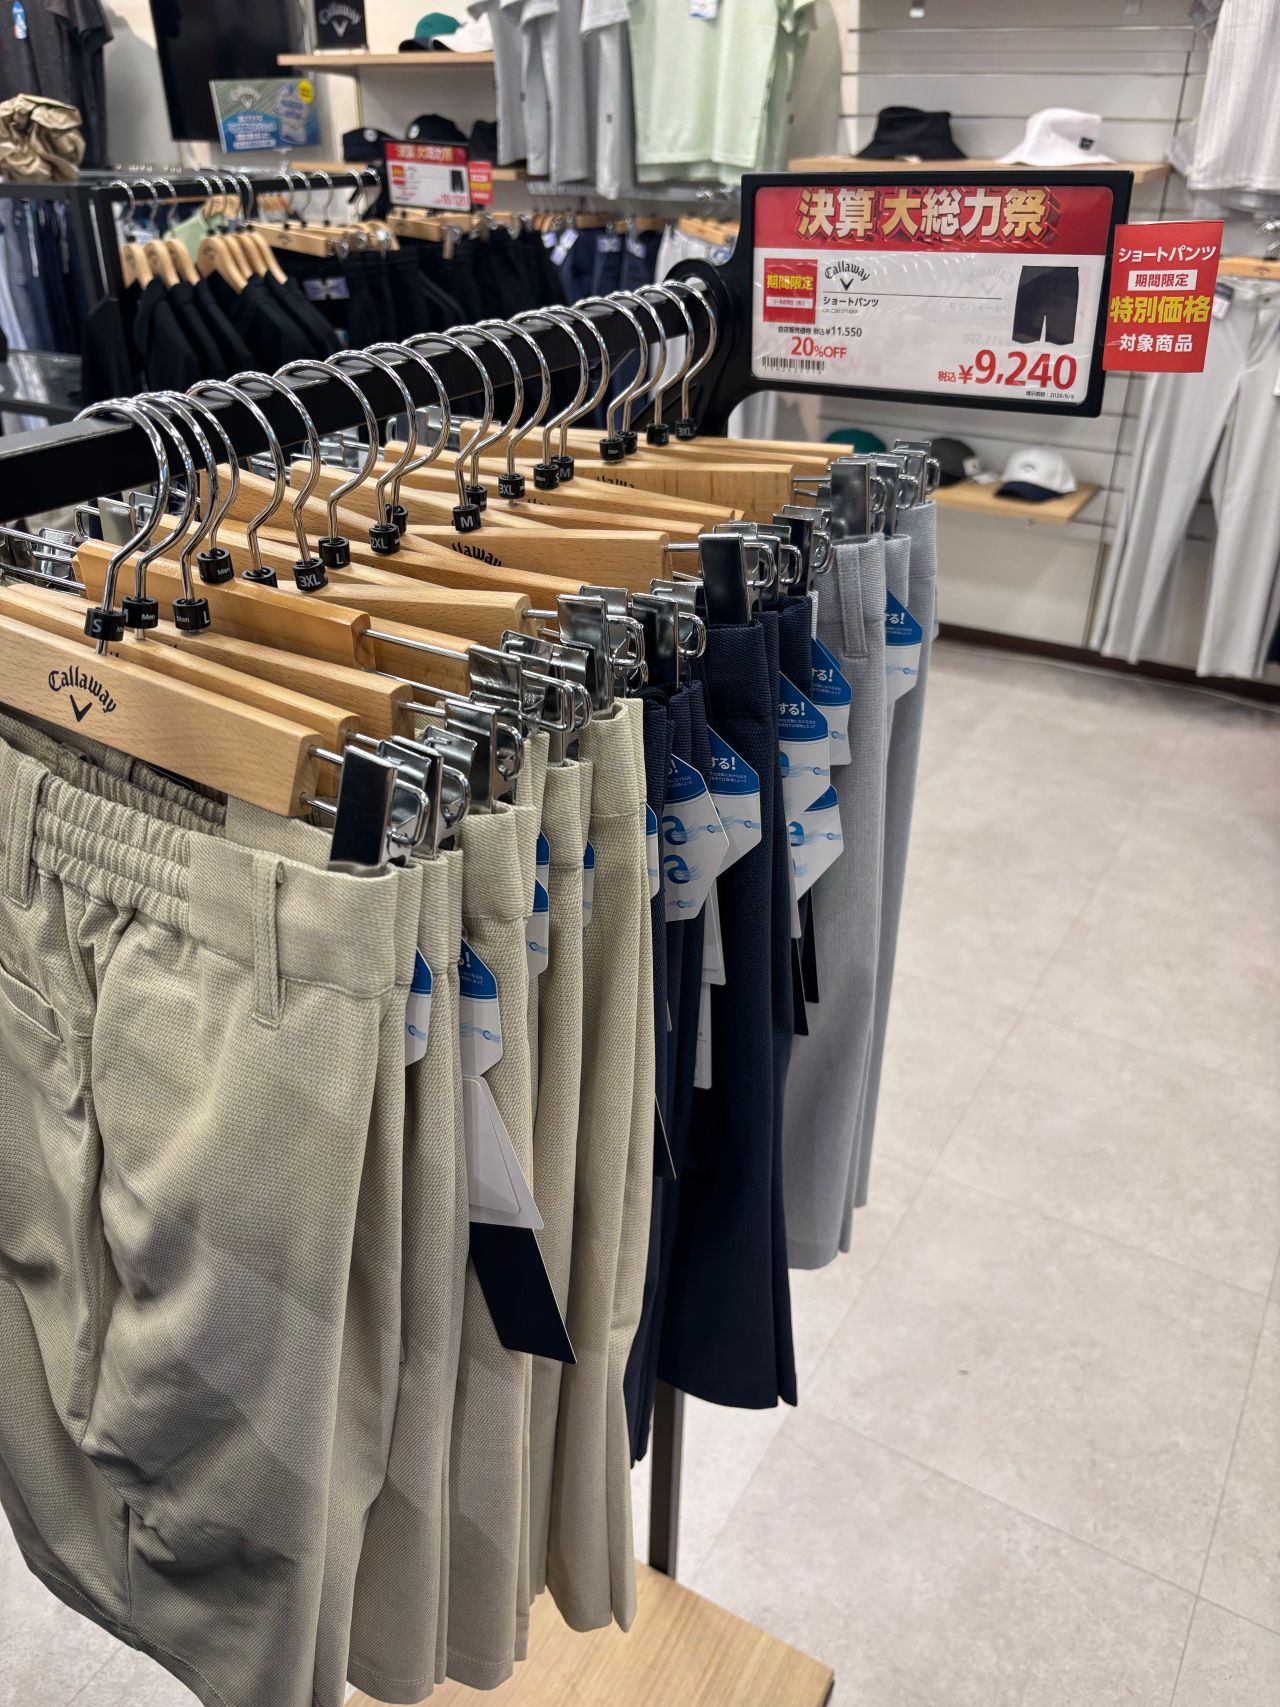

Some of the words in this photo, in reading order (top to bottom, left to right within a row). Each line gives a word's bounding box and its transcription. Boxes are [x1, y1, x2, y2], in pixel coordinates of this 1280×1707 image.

[1118, 244, 1217, 263] ショートパンツ
[824, 260, 870, 281] Callaway
[766, 274, 814, 291] 期間限定
[1134, 273, 1189, 288] 期間限定
[823, 296, 879, 307] ショートパンツ
[1110, 294, 1211, 323] 特別価格
[1119, 332, 1193, 353] 対象商品
[560, 467, 571, 478] M
[460, 515, 474, 529] M
[335, 553, 344, 565] L
[300, 573, 321, 588] 3XL
[141, 612, 156, 620] Men
[203, 610, 210, 624] L
[92, 618, 102, 633] S
[48, 665, 117, 713] Callaway
